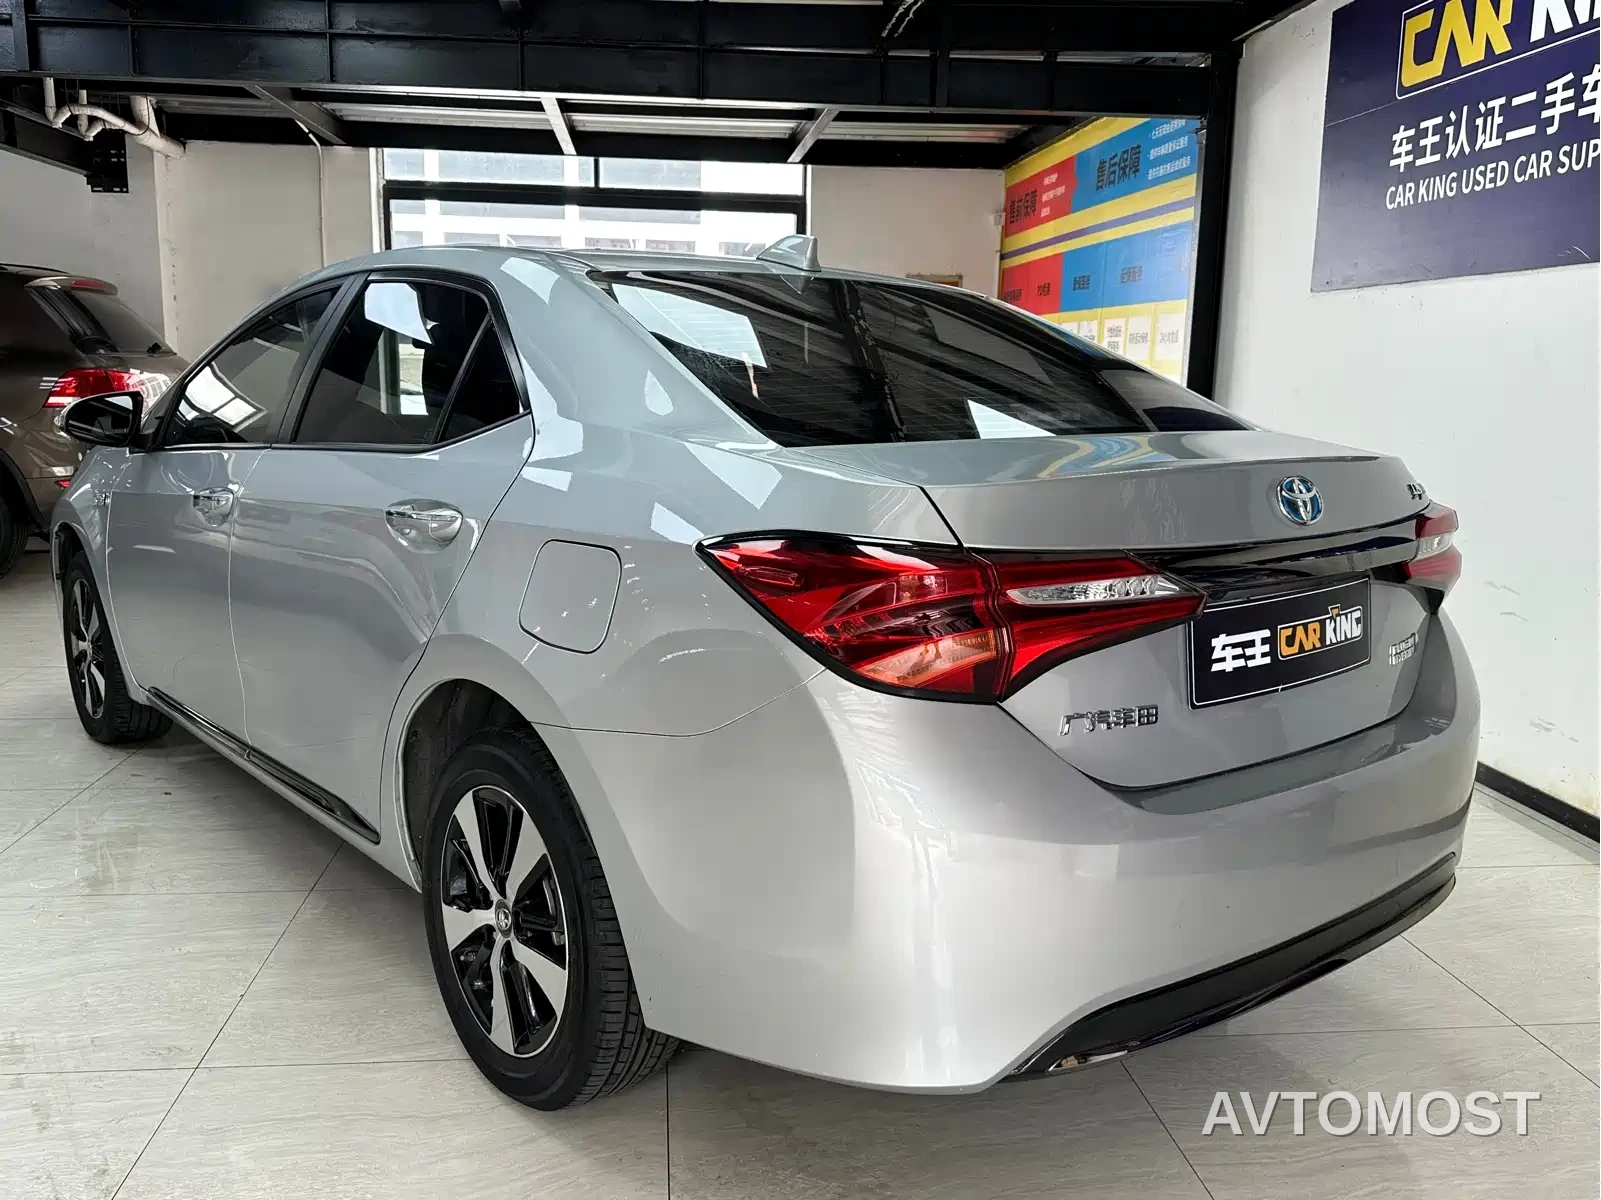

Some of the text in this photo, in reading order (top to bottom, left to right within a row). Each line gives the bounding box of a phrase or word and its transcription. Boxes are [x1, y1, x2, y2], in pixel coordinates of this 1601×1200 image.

[1401, 0, 1513, 88] CAR
[1389, 63, 1600, 173] 车王认证二手车
[1095, 143, 1142, 192] 售后保障
[1385, 182, 1414, 210] CAR
[1417, 172, 1457, 204] KING
[1461, 160, 1509, 194] USED
[1513, 149, 1553, 184] CAR
[1210, 628, 1271, 673] 车王
[1280, 621, 1321, 656] CAR
[1325, 609, 1362, 645] KING
